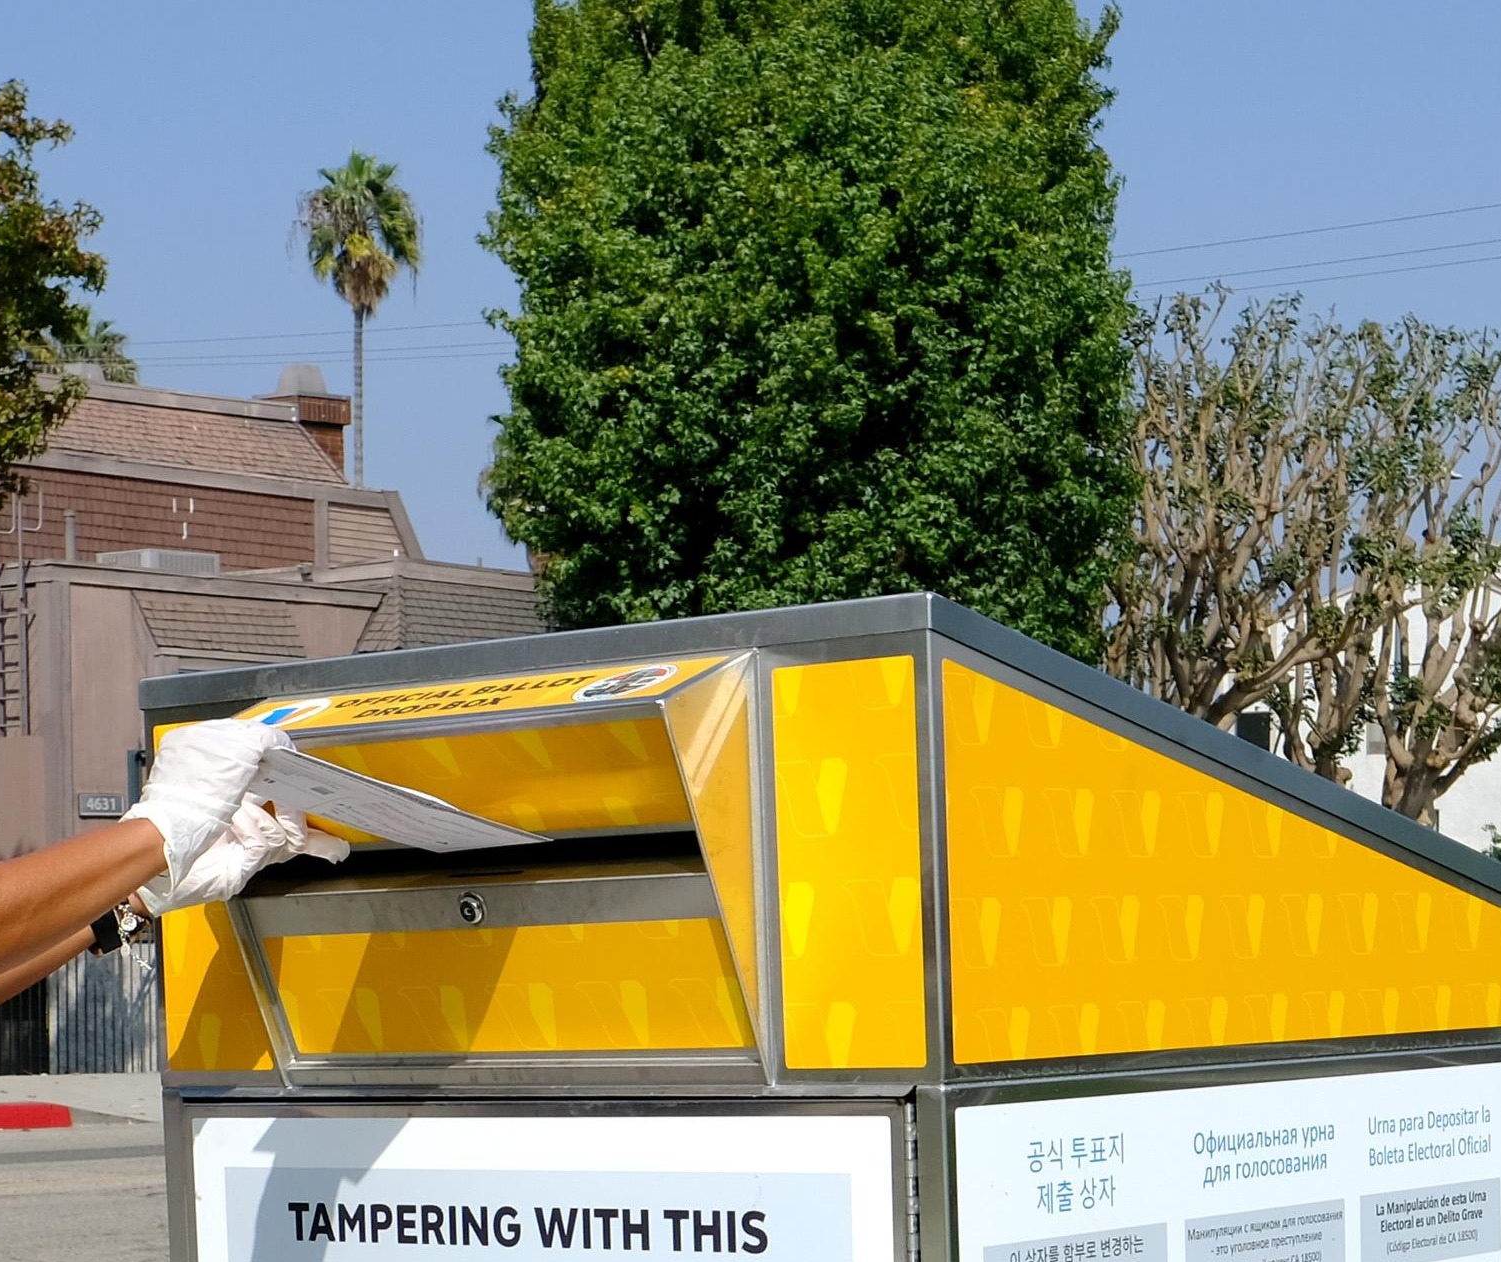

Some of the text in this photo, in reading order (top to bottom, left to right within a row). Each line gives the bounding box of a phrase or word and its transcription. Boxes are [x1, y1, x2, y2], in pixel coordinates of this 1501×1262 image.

[333, 674, 596, 709] OFFICIAL BALLOT
[352, 697, 511, 720] DROP BOX
[86, 797, 117, 812] 4631
[1369, 1105, 1490, 1136] Urna para Depositar la
[1027, 1133, 1123, 1173] 공식 투표지
[1194, 1125, 1334, 1158] Официальная урна
[1369, 1134, 1490, 1166] Boleta Electoral Oficial
[1203, 1154, 1327, 1188] для голосования
[1037, 1176, 1116, 1213] 제출 상자
[288, 1202, 768, 1254] TAMPERING WITH THIS
[1381, 1209, 1482, 1232] Electoral es un Delito Grave
[1064, 1242, 1096, 1262] 함부로
[1101, 1235, 1143, 1258] 변경하는
